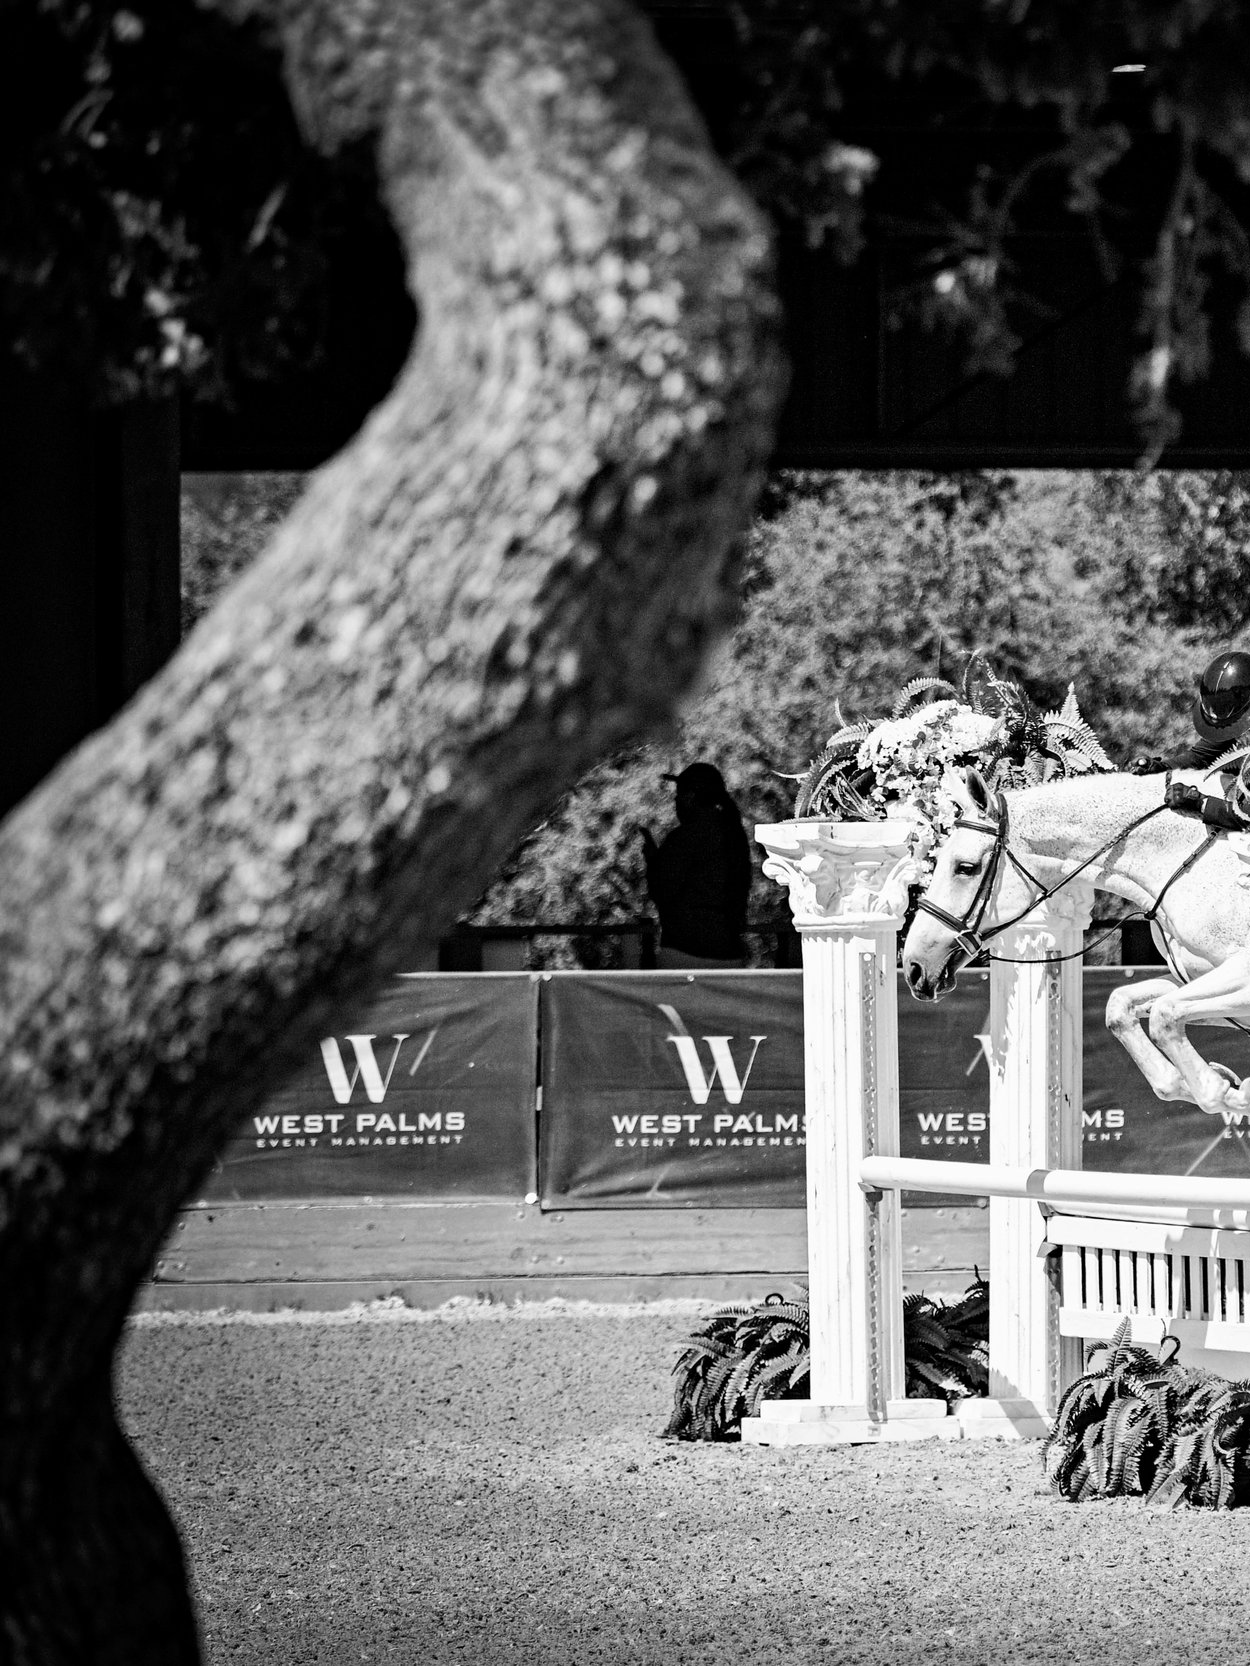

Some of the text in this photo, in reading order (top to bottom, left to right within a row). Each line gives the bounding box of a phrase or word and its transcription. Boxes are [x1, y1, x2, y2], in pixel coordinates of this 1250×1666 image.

[320, 1034, 410, 1104] W
[666, 1035, 767, 1104] W
[254, 1112, 465, 1134] WEST PALMS
[611, 1113, 807, 1134] WEST PALM
[917, 1112, 990, 1132] WES
[256, 1134, 464, 1148] EVENT MANAGEMENT
[614, 1136, 807, 1147] EVENT MANAGEMEN
[921, 1136, 982, 1145] EVENT
